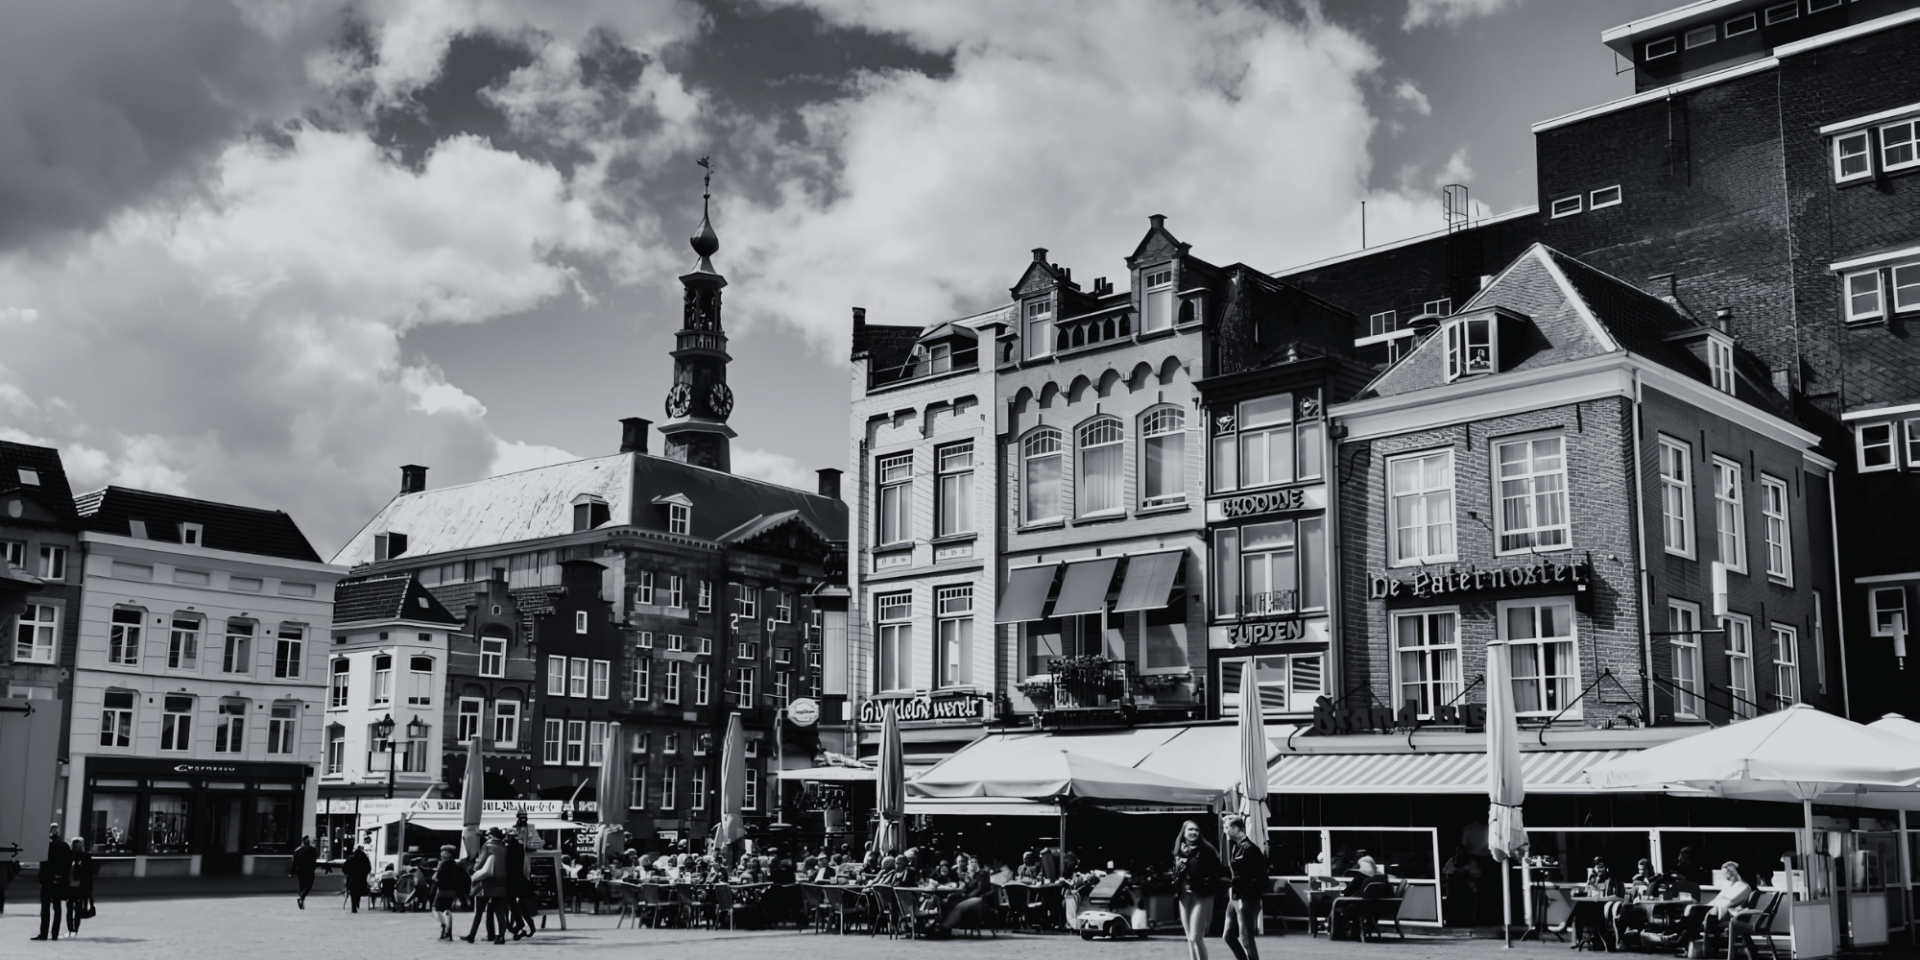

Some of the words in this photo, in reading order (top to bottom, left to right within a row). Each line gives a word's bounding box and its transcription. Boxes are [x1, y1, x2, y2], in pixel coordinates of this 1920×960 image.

[1222, 489, 1304, 517] BROODJE
[1371, 575, 1400, 599] De
[1412, 562, 1580, 597] Paternoster
[1227, 619, 1305, 645] FLIPSEN
[1313, 695, 1418, 736] Brand
[1434, 703, 1487, 733] BIE
